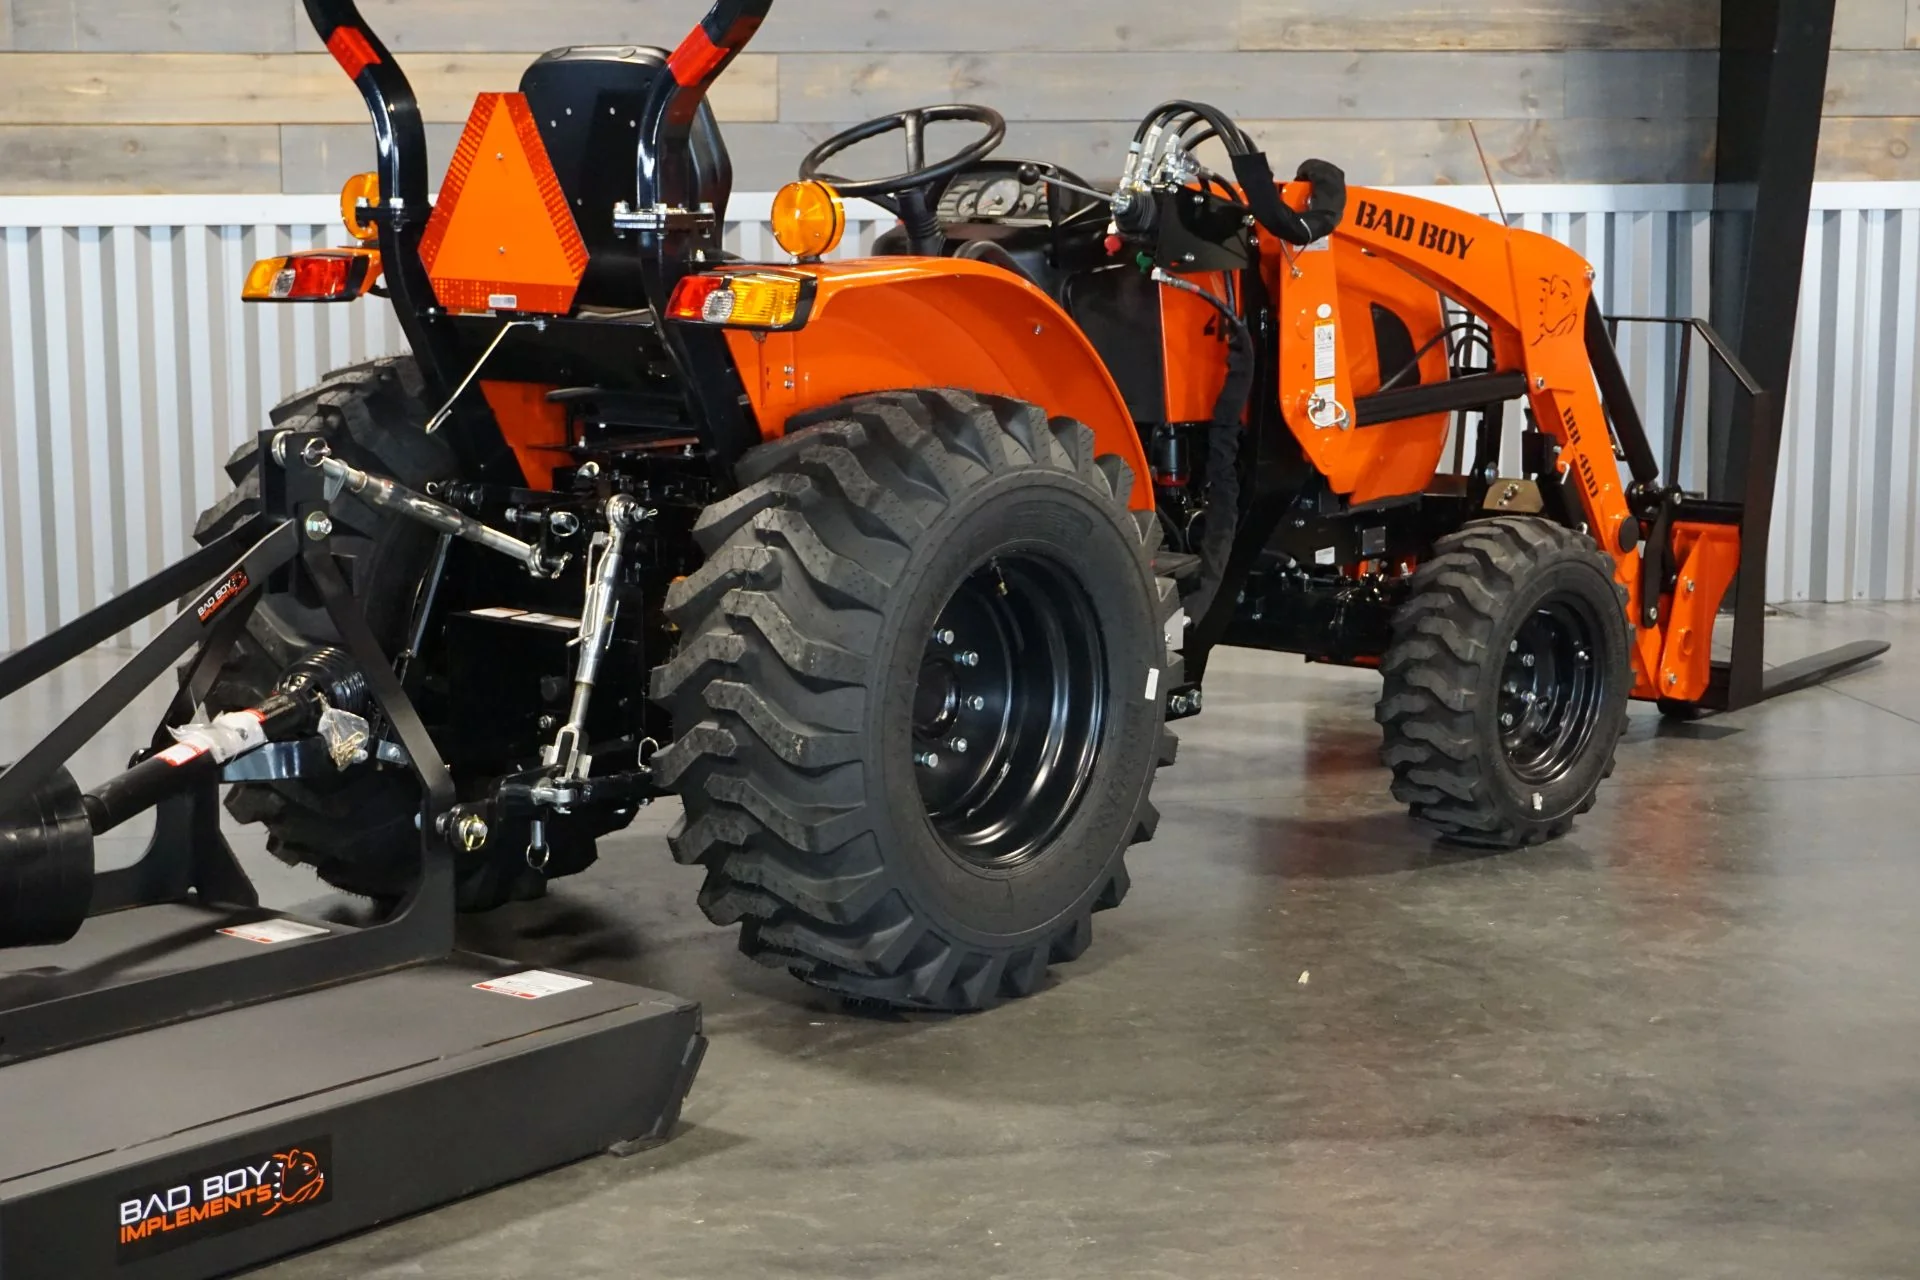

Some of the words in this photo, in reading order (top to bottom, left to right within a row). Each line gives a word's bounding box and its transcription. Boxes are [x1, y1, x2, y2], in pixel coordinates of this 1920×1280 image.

[1355, 200, 1416, 242] BAD
[1418, 221, 1475, 260] BOY
[1579, 453, 1599, 498] 400
[197, 596, 215, 617] BAD
[215, 579, 231, 600] BOY
[120, 1185, 191, 1225] BAD
[203, 1161, 271, 1201] BOY
[120, 1184, 273, 1244] IMPLEMENTS
